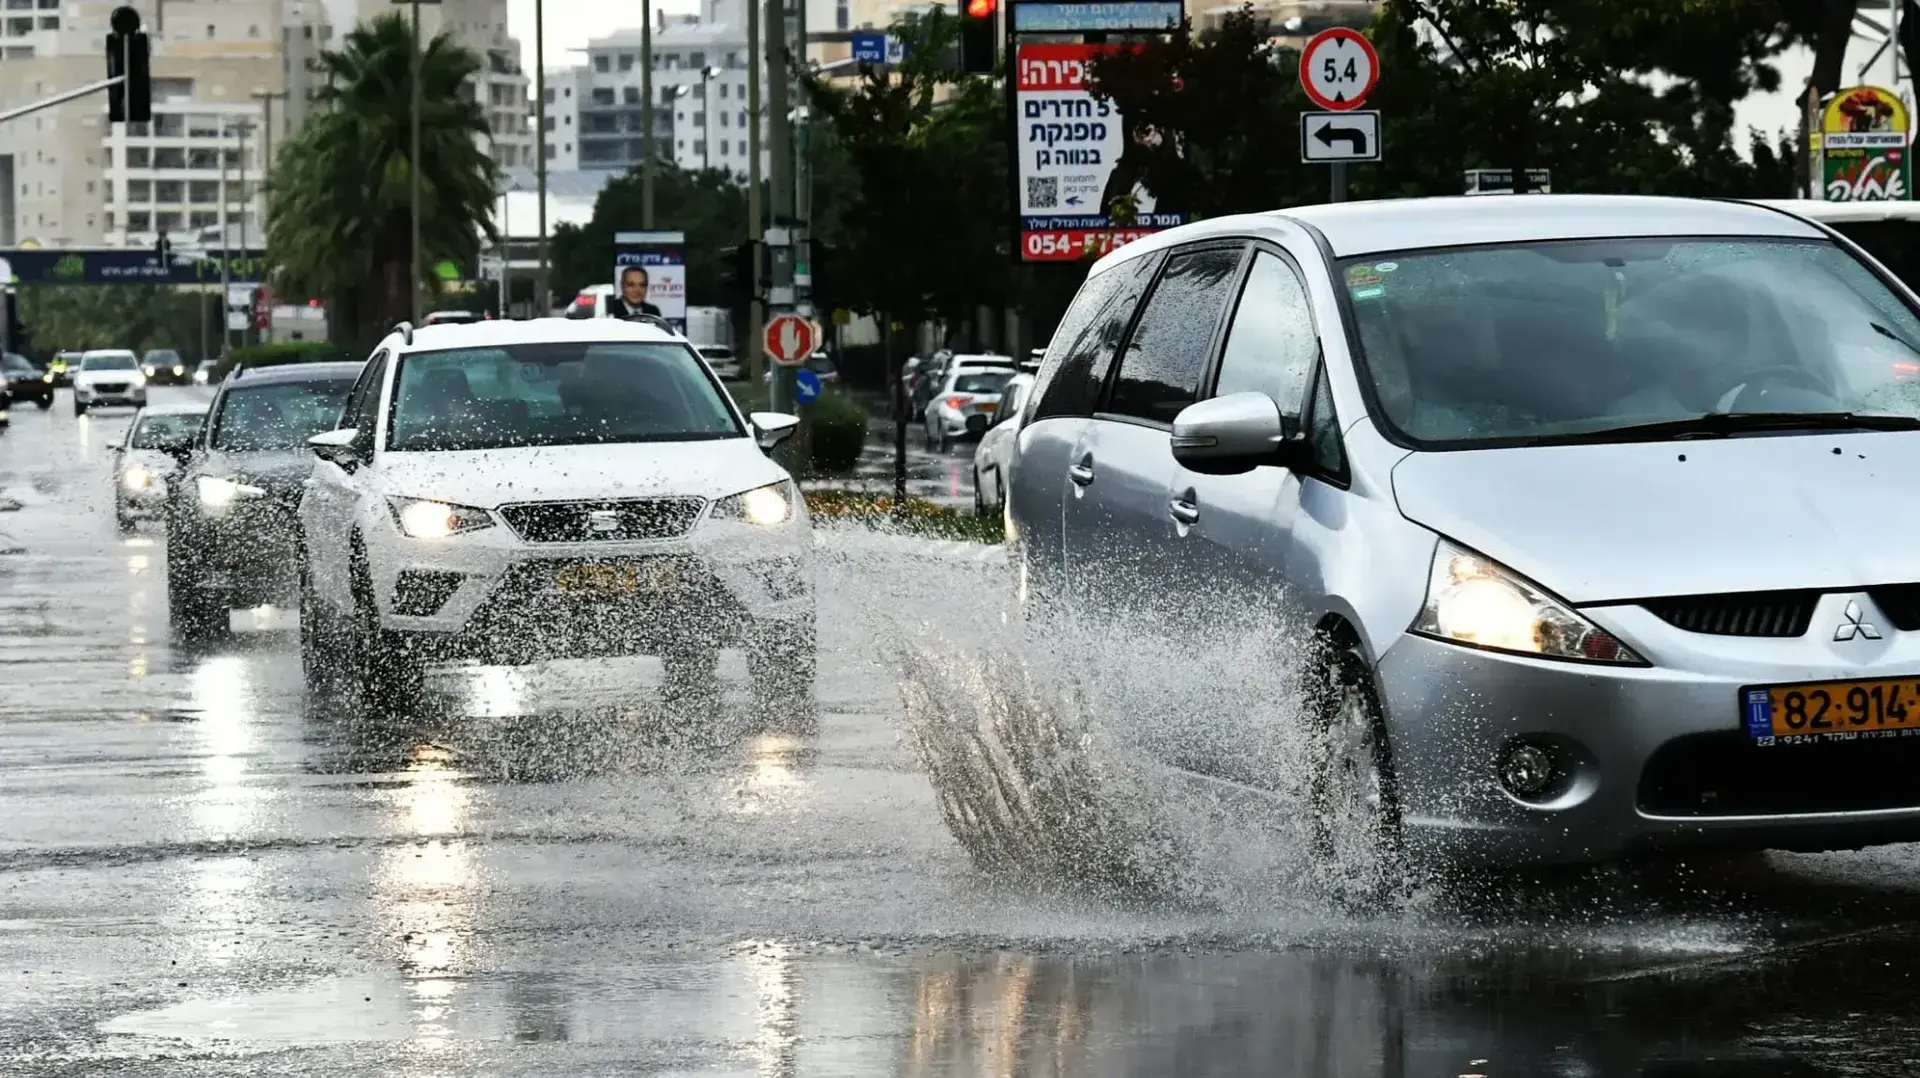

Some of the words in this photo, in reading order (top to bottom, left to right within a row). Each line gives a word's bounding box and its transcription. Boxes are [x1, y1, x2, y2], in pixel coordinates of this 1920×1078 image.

[1323, 57, 1357, 83] 5.4
[1025, 99, 1091, 118] חדרים
[1097, 100, 1110, 117] 5
[1029, 122, 1107, 147] מפנקת
[1036, 150, 1051, 171] גן
[1055, 149, 1102, 166] בנווה
[1028, 219, 1048, 231] שלך
[1156, 214, 1181, 226] תמר
[1752, 704, 1767, 722] IL
